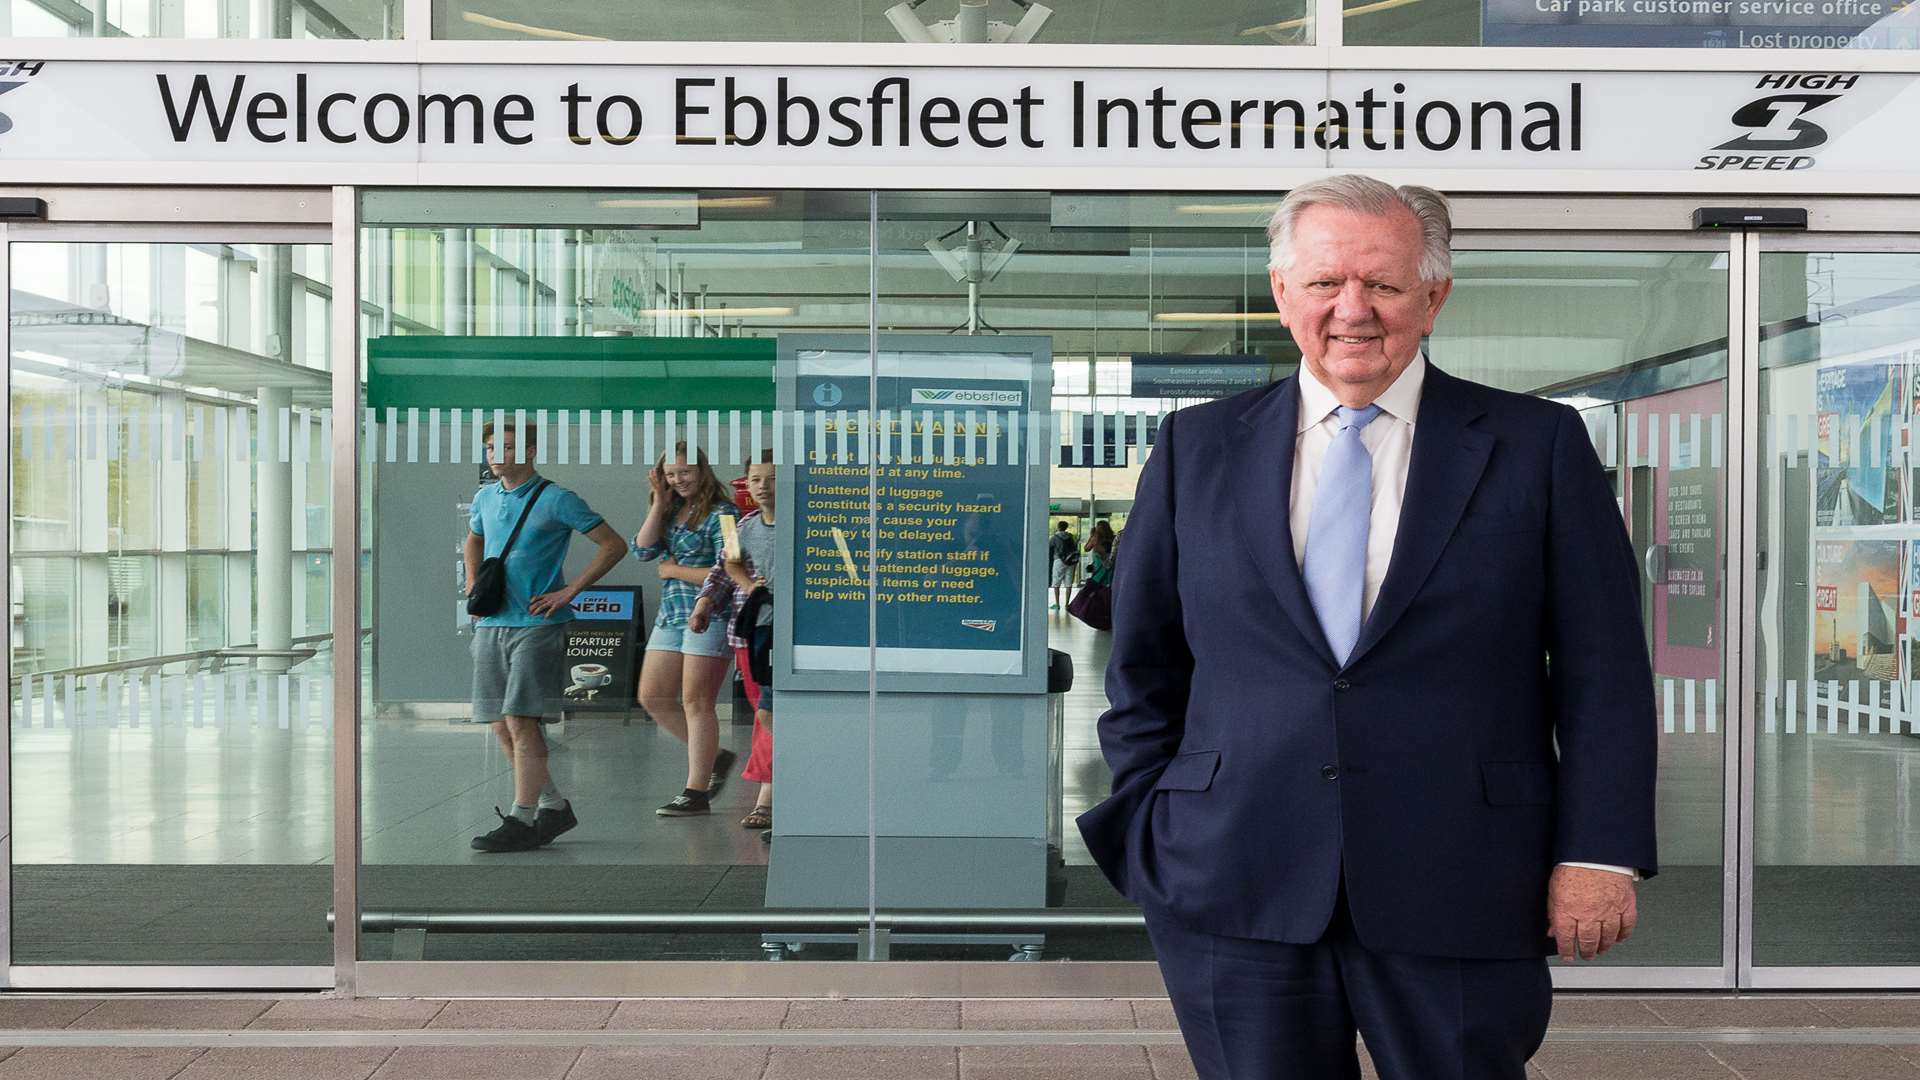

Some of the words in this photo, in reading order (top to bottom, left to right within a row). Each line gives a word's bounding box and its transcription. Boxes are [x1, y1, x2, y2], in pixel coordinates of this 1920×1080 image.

[1535, 0, 1570, 12] Car
[1578, 0, 1626, 15] park
[1632, 0, 1731, 13] customer
[1739, 0, 1815, 14] service
[1822, 0, 1881, 14] office
[1738, 30, 1784, 48] Lost
[1788, 33, 1877, 48] property
[1755, 74, 1861, 90] HIGH
[156, 73, 534, 144] Welcome
[560, 82, 643, 145] to
[675, 76, 1044, 148] Ebbsfleet
[1072, 80, 1582, 152] International
[1694, 156, 1816, 170] SPEED
[955, 391, 1021, 402] ebbsfleet
[888, 468, 901, 477] at
[904, 469, 929, 479] any
[932, 468, 965, 478] time.
[808, 484, 886, 496] Unattendd
[889, 487, 944, 499] luggage
[898, 502, 952, 514] security
[956, 502, 1001, 513] hazard
[807, 514, 847, 524] which
[882, 516, 923, 526] cause
[927, 517, 958, 528] your
[879, 529, 895, 539] be
[899, 529, 955, 541] delayed.
[855, 548, 892, 561] noify
[896, 550, 943, 560] station
[946, 550, 978, 561] staff
[980, 551, 990, 561] if
[806, 563, 831, 573] you
[863, 564, 937, 574] uattended
[942, 565, 999, 577] luggage,
[883, 577, 919, 588] items
[923, 580, 937, 588] or
[941, 579, 974, 589] need
[805, 589, 834, 602] help
[837, 590, 865, 601] with
[873, 593, 894, 604] ny
[897, 592, 933, 602] other
[936, 593, 983, 604] matter.
[569, 637, 621, 646] EPARTURE
[567, 648, 613, 656] LOUNGE
